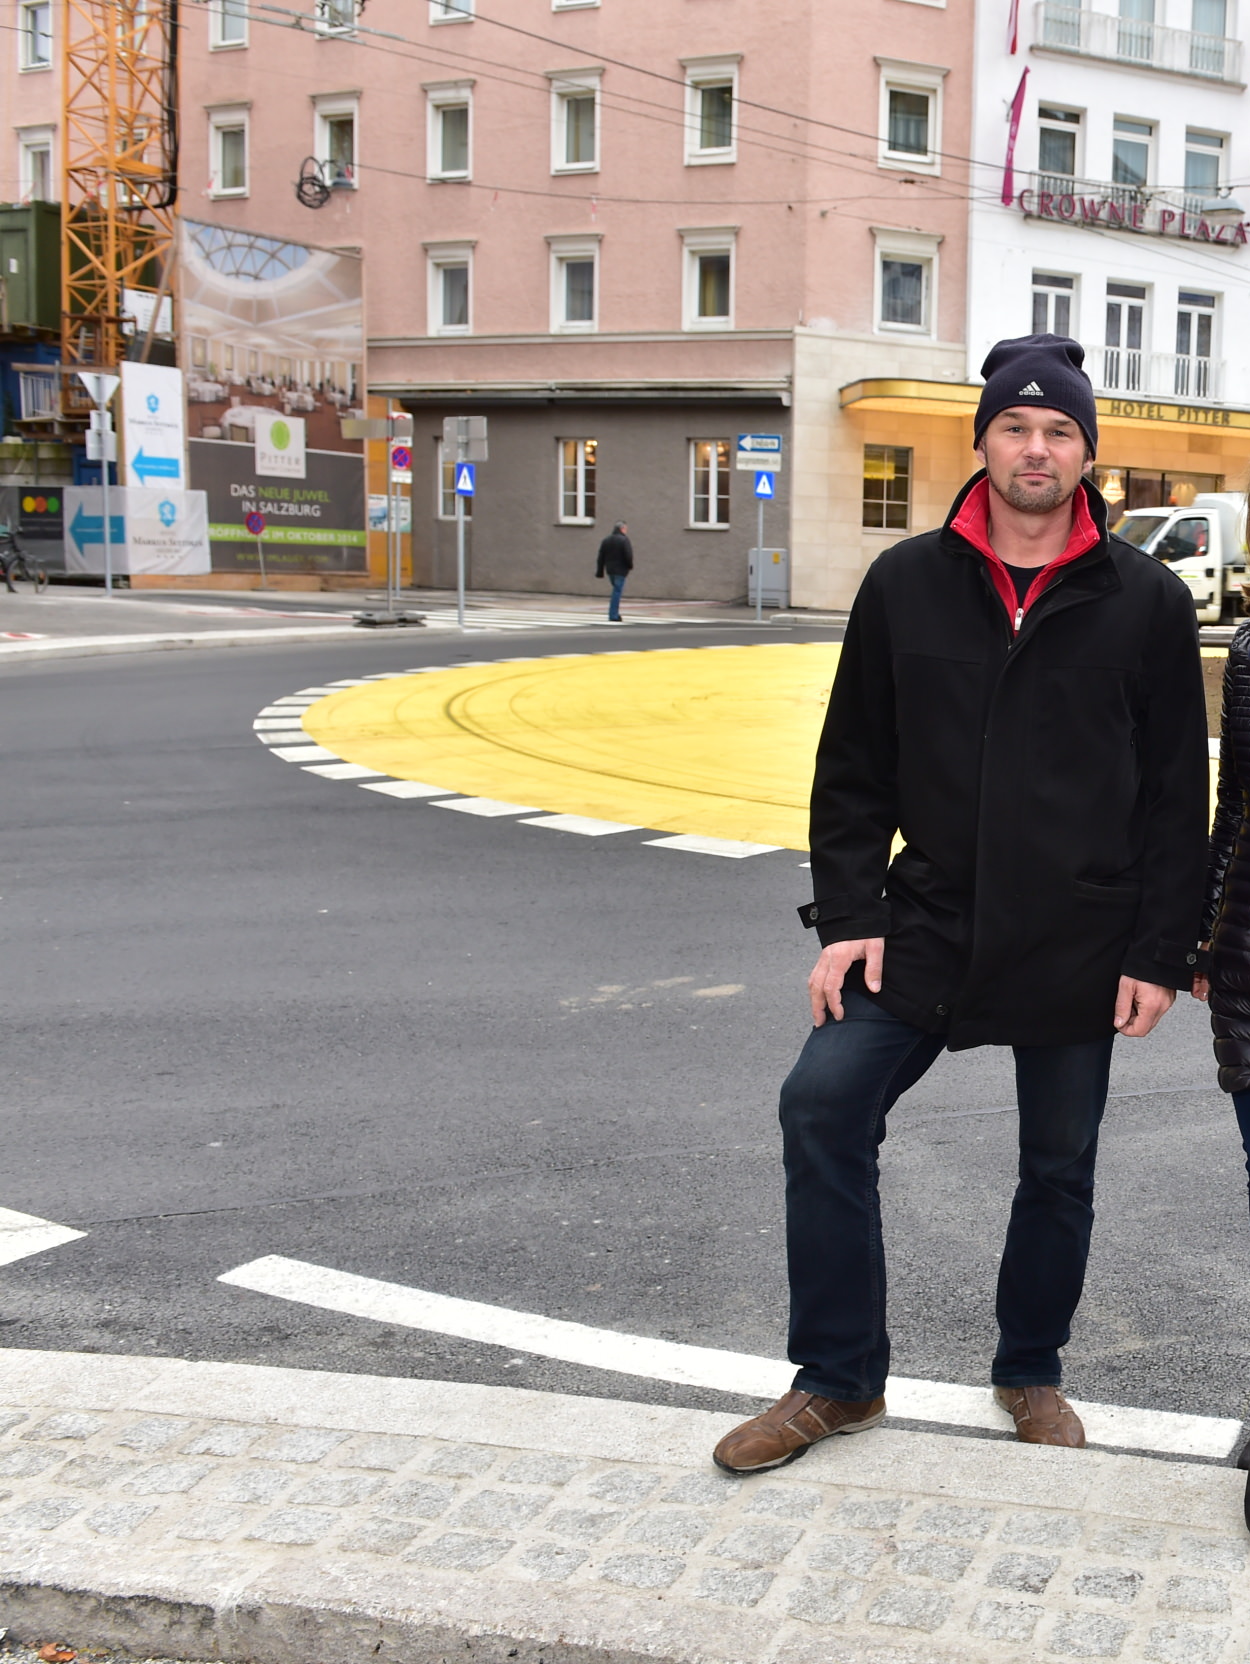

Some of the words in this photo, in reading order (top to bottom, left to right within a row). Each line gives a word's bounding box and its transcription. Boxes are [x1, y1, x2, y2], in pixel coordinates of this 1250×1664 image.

[1018, 189, 1146, 229] CROWNE
[1161, 209, 1248, 244] PLAZA
[1110, 400, 1165, 419] HOTEL
[1177, 407, 1230, 425] PITTER
[260, 451, 301, 466] PITTER
[230, 484, 256, 498] DAS
[257, 486, 291, 501] NEUE
[292, 489, 331, 503] JUWEL
[242, 501, 256, 513] IN
[259, 502, 321, 517] SALZBURG
[287, 531, 335, 542] OKTOBER
